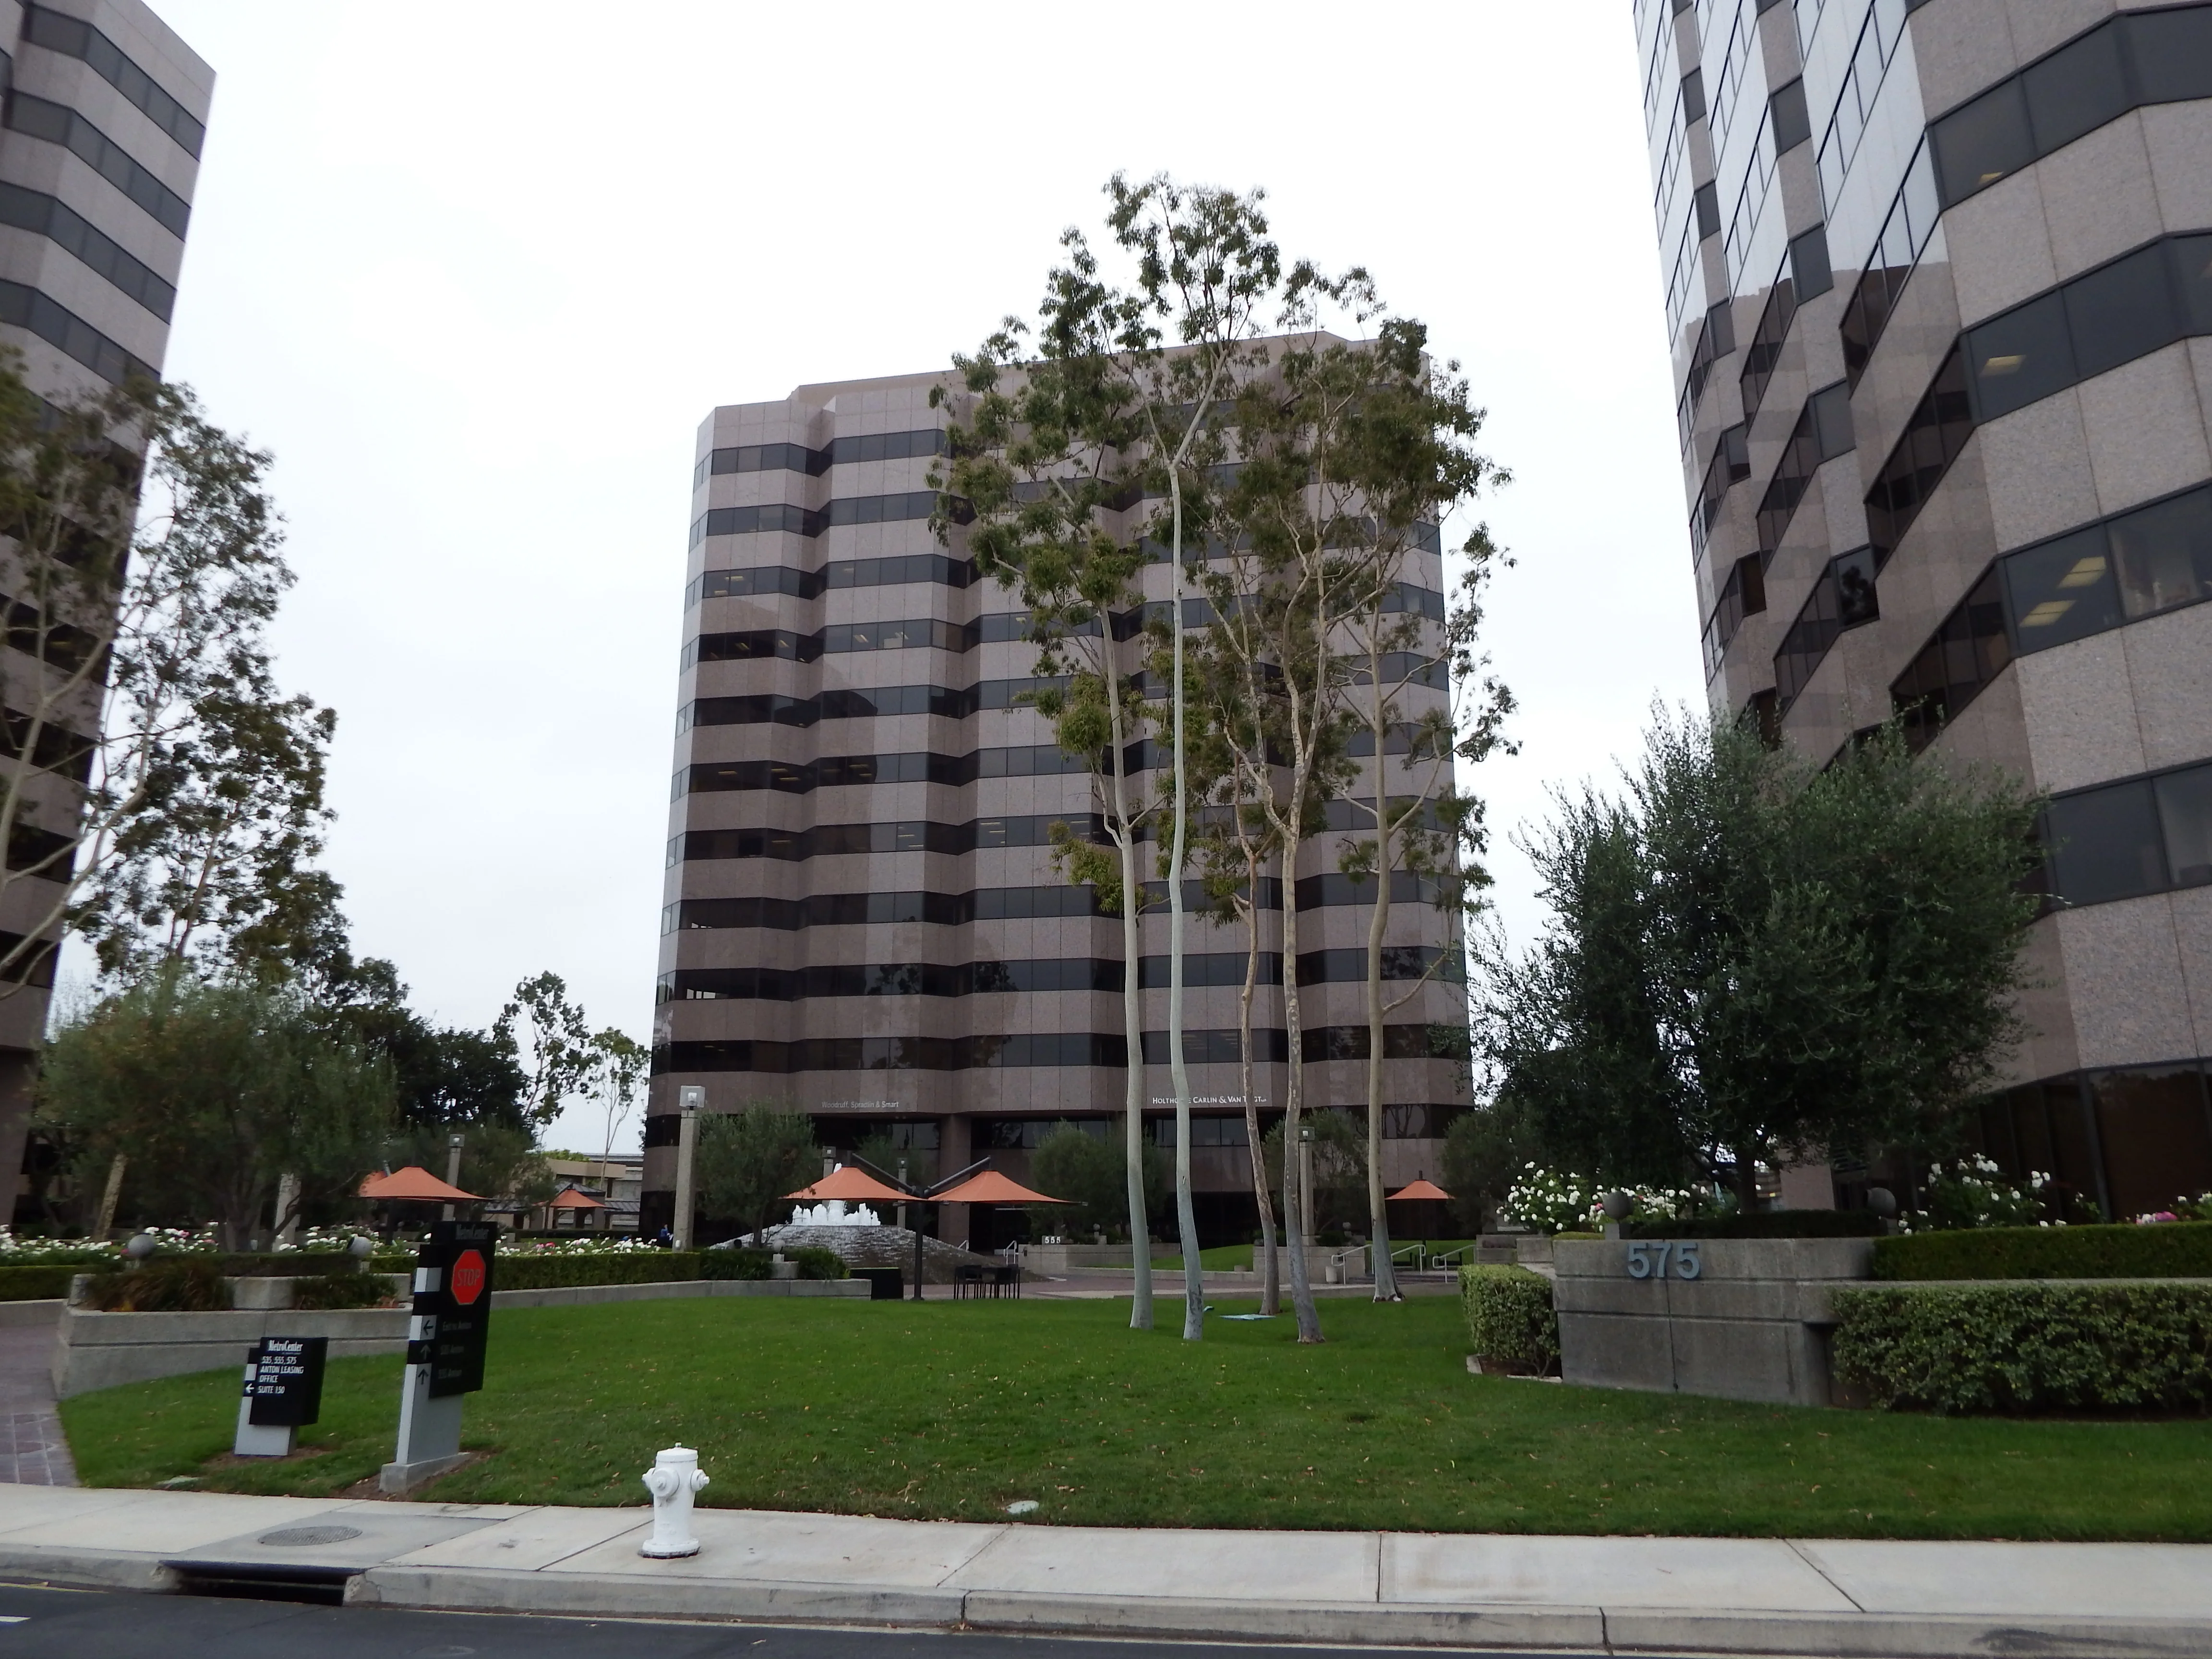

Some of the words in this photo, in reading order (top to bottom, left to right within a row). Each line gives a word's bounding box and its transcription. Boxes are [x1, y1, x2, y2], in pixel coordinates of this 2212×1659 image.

[851, 1101, 874, 1109] Spradlin
[1627, 1242, 1700, 1279] 575
[457, 1268, 481, 1286] STOP
[267, 1340, 303, 1352] MetroCenter
[286, 1356, 297, 1364] 575
[260, 1365, 280, 1373] ANTON
[280, 1366, 304, 1374] LEASING
[258, 1374, 279, 1383] OFFICE
[257, 1385, 274, 1394] SUITE
[274, 1386, 285, 1394] 150
